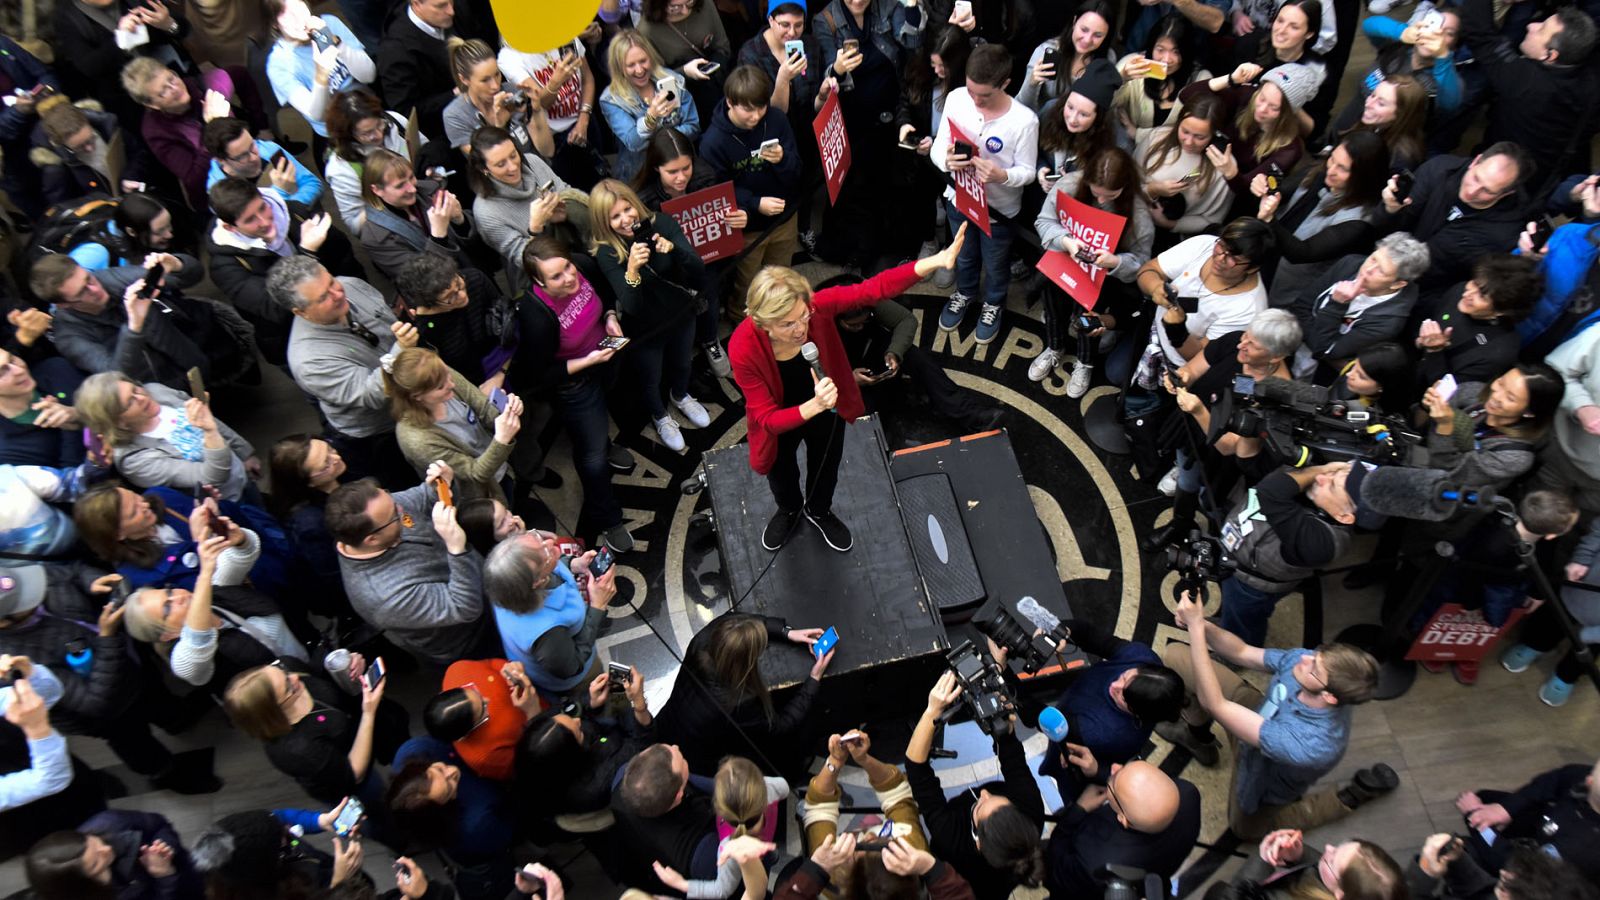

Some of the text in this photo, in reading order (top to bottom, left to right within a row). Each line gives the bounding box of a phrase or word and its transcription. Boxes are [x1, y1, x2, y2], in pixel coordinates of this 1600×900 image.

[825, 126, 846, 181] DEBT
[956, 168, 985, 208] DEBT
[678, 206, 733, 235] TUDENT
[1059, 209, 1111, 251] CANCEL
[1420, 631, 1498, 647] DEBT
